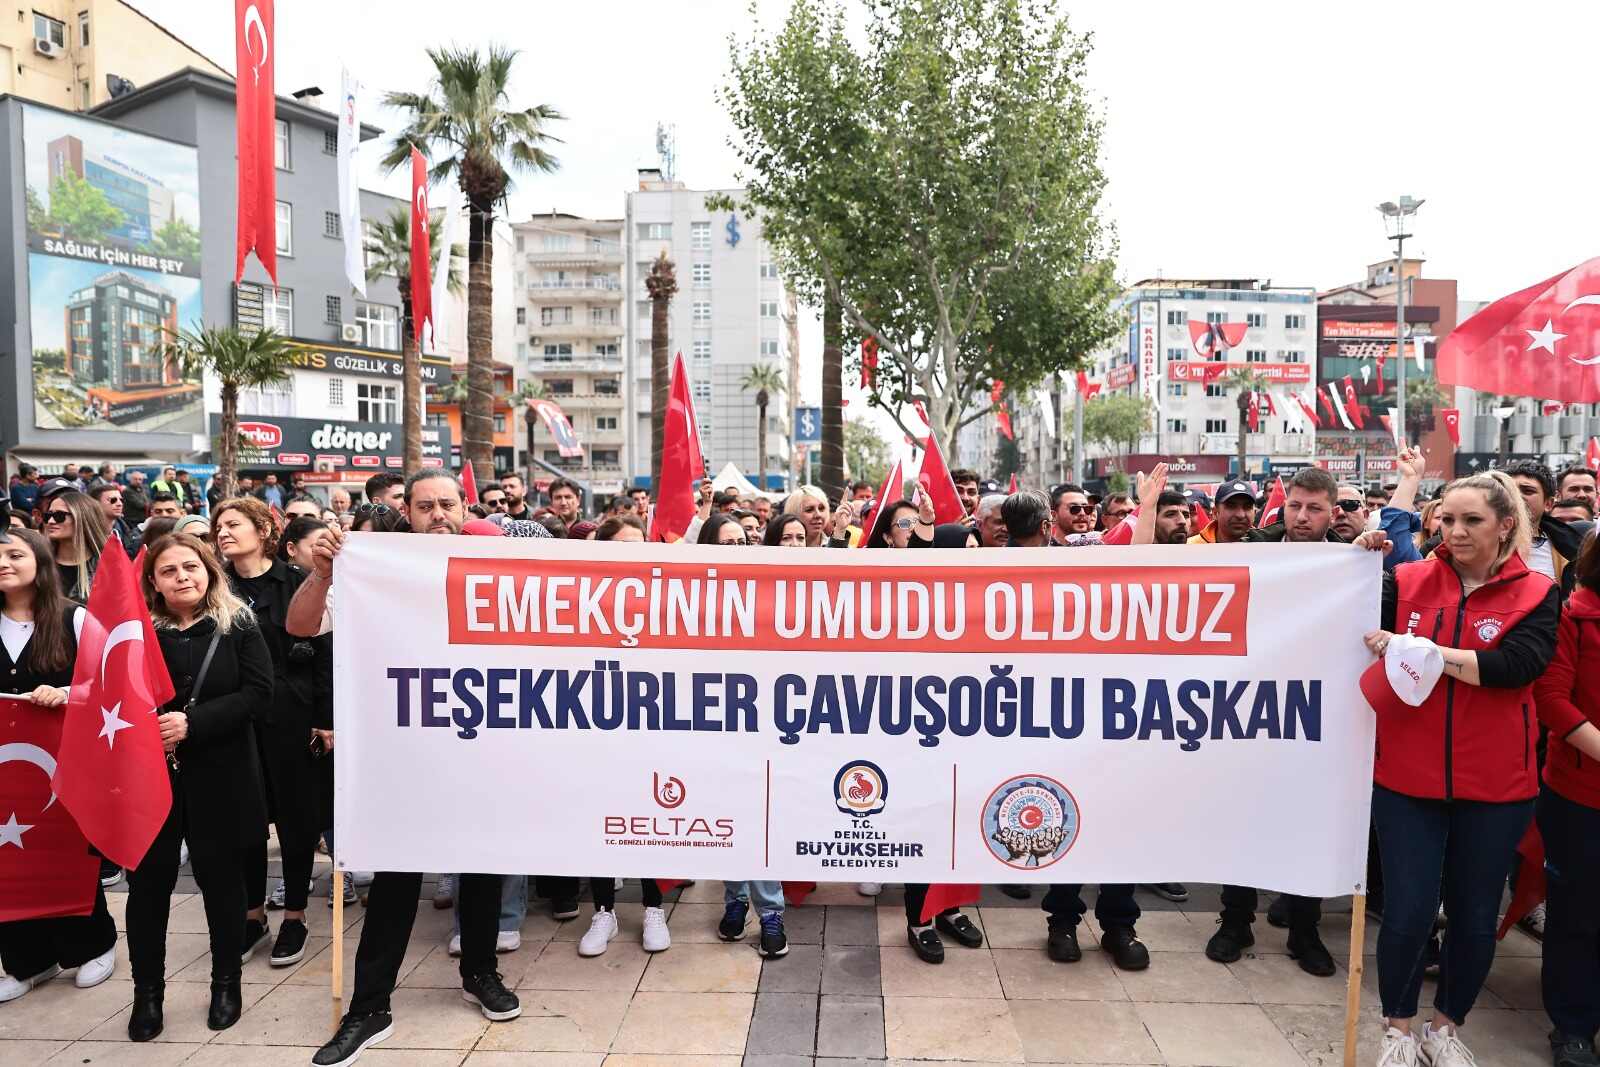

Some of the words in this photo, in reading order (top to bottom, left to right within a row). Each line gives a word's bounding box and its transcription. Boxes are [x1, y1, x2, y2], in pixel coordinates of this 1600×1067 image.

[44, 239, 98, 260] SAĞLIK
[100, 246, 130, 265] İÇİN
[132, 255, 158, 269] HER
[160, 260, 184, 273] ŞEY
[334, 356, 387, 374] GÜZELLİK
[392, 363, 436, 379] SNU
[311, 423, 392, 453] döner
[1327, 461, 1357, 470] BURG
[1367, 461, 1392, 470] KING
[465, 567, 756, 648] EMEKÇİNİN
[774, 579, 965, 641] UMUDU
[984, 581, 1236, 643] OLDUNUZ
[387, 660, 759, 740] TEŞEKKÜRLER
[773, 664, 1085, 748] ÇAVUŞOĞLU
[1102, 678, 1322, 752] BAŞKAN
[604, 816, 734, 840] BELTAŞ
[851, 819, 873, 829] T.C.
[647, 839, 692, 848] BÜYÜKŞEHİR
[692, 840, 734, 848] BELEDİYESİ
[796, 841, 924, 858] BÜYÜKŞEHİR
[821, 859, 899, 868] BELEDİYESİ
